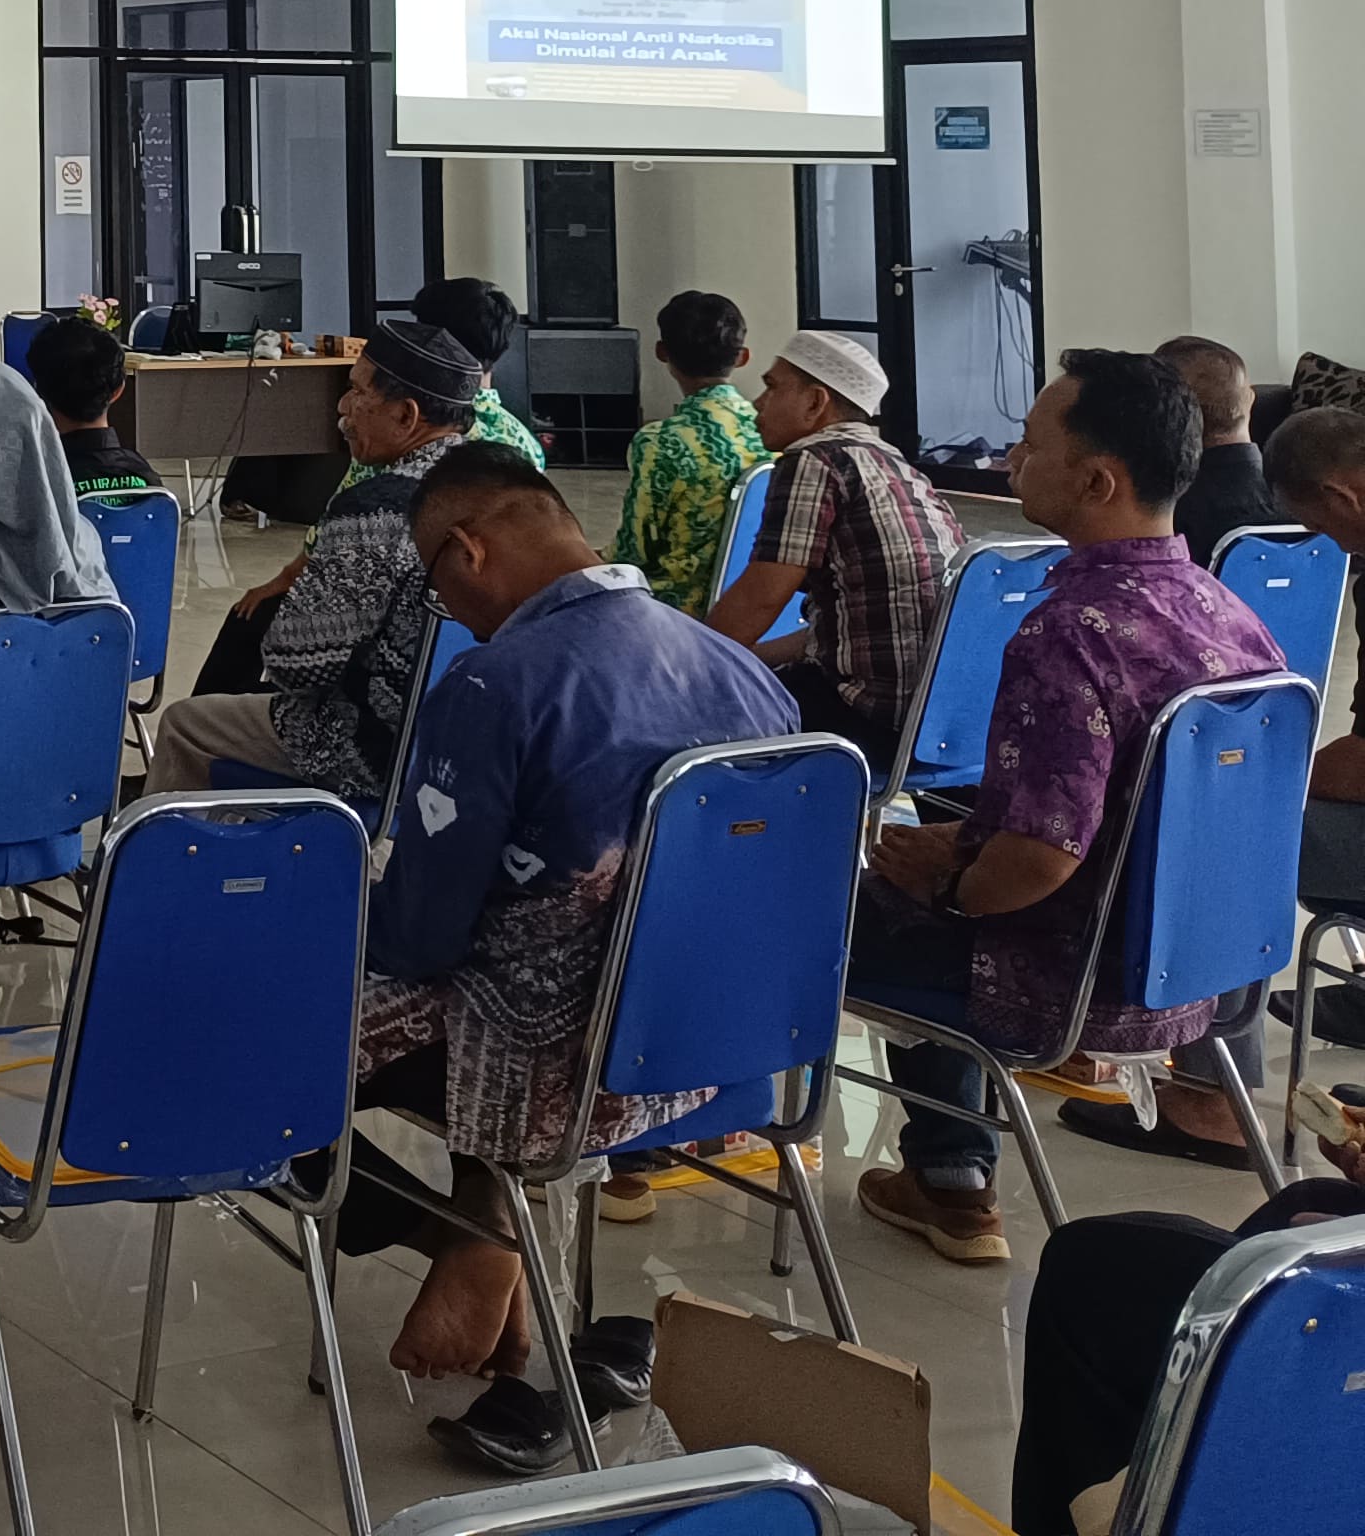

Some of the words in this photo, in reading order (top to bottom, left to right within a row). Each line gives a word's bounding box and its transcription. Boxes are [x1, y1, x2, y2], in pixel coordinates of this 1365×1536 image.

[498, 27, 540, 41] Aksi
[544, 28, 628, 43] Nasional
[632, 31, 674, 45] Anti
[678, 32, 775, 48] Narkotika
[536, 44, 616, 60] Dimulai
[622, 46, 666, 61] dari
[670, 48, 729, 63] Anak
